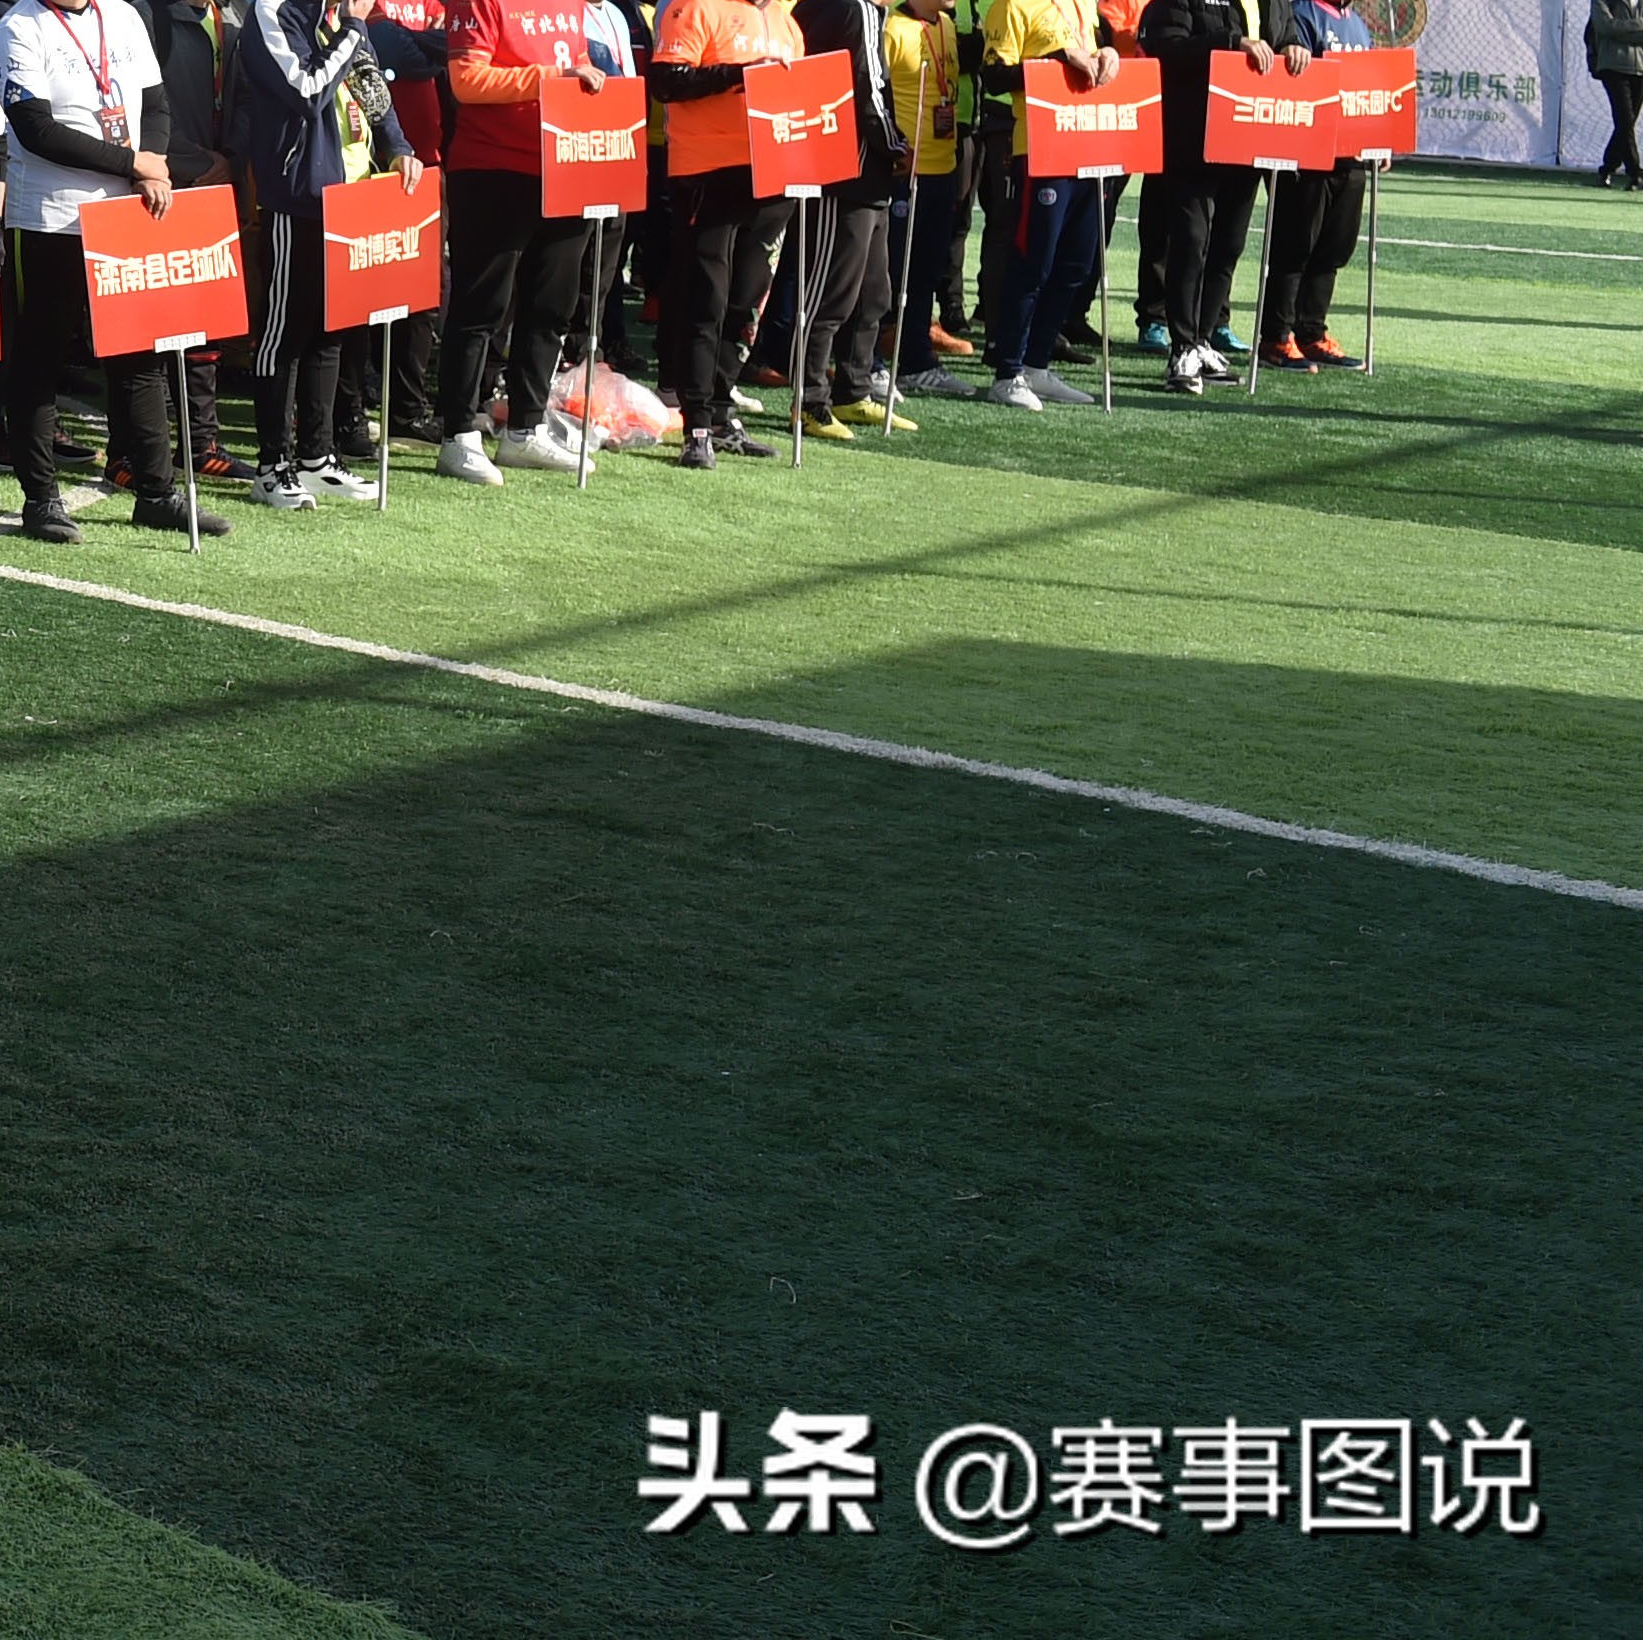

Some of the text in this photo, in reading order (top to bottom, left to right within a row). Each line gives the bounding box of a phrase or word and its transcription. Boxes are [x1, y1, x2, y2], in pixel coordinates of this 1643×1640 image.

[94, 244, 238, 297] 滦南县足球队
[349, 226, 420, 271] 鸿博实业
